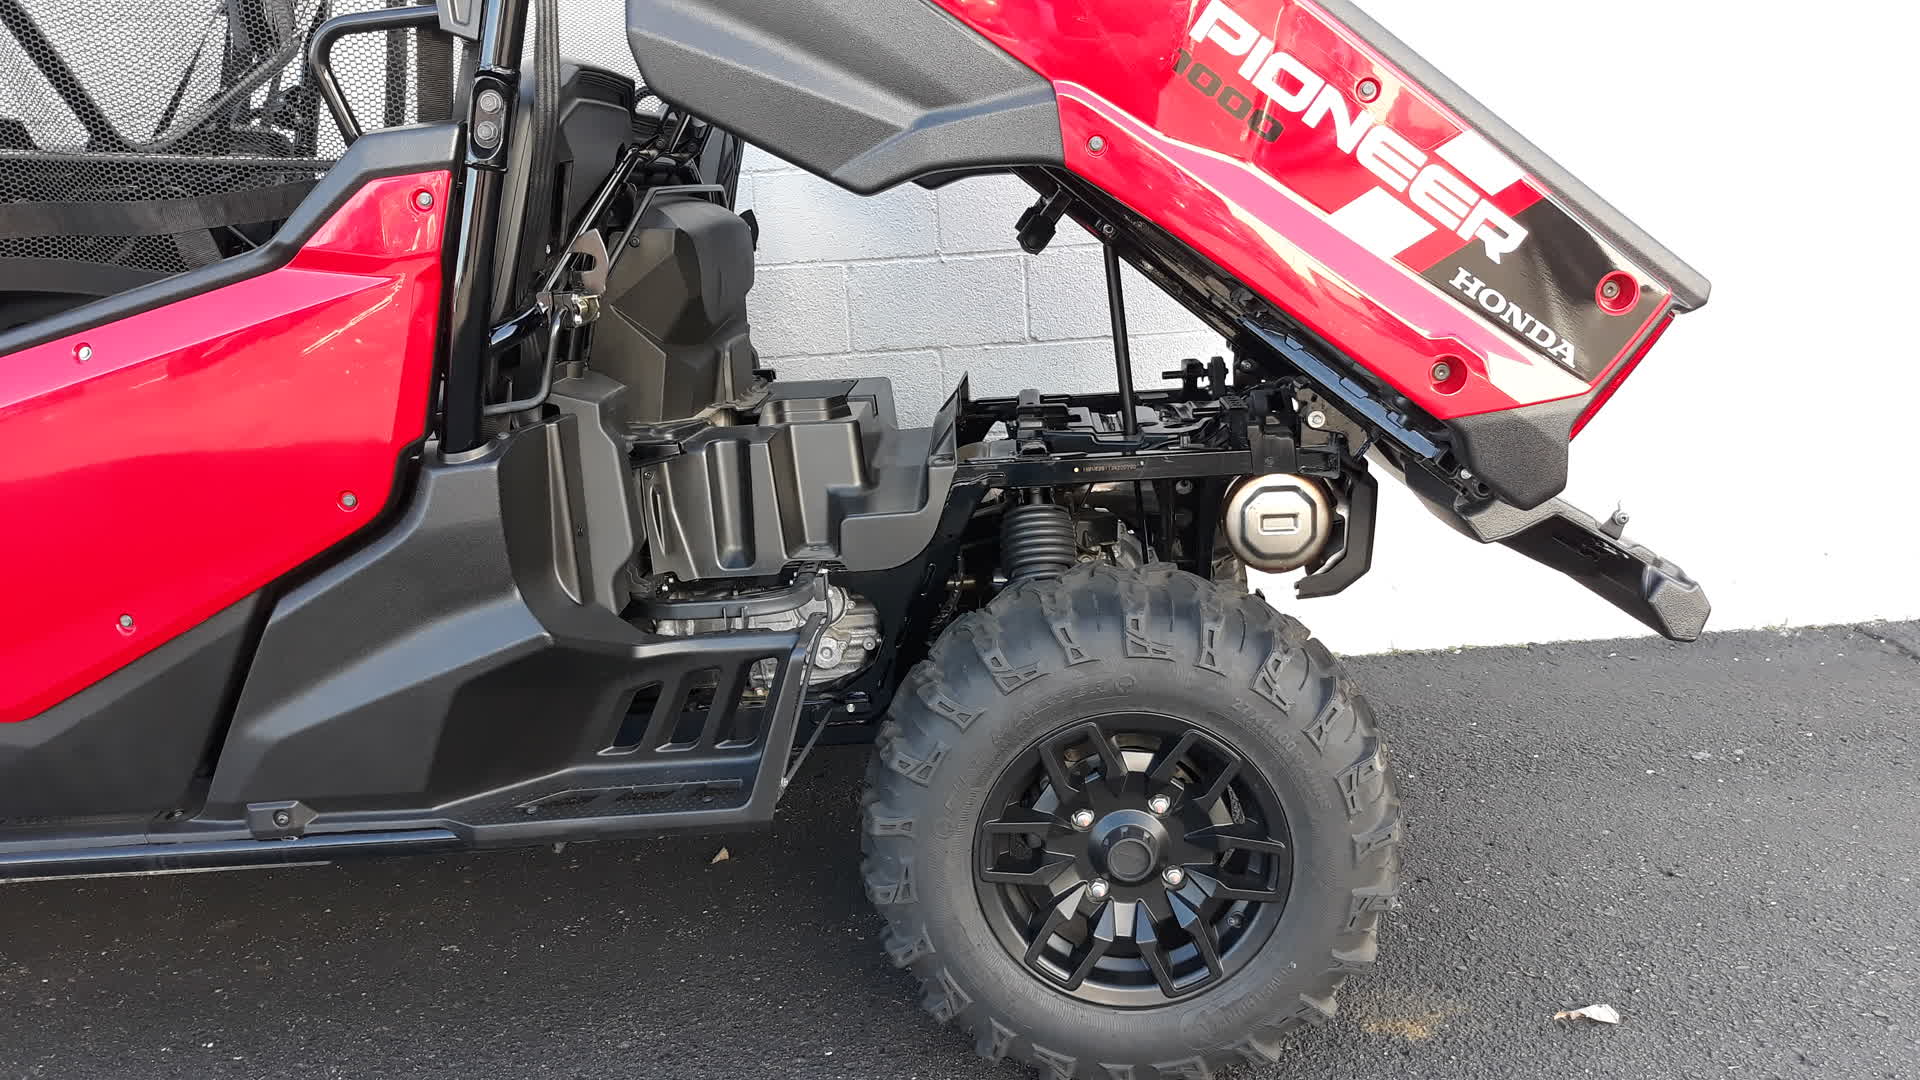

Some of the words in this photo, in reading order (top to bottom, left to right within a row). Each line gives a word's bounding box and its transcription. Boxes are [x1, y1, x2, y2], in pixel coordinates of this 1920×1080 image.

[1172, 48, 1284, 143] 1000
[1188, 0, 1528, 265] PIONEER
[1449, 266, 1577, 369] HONDA
